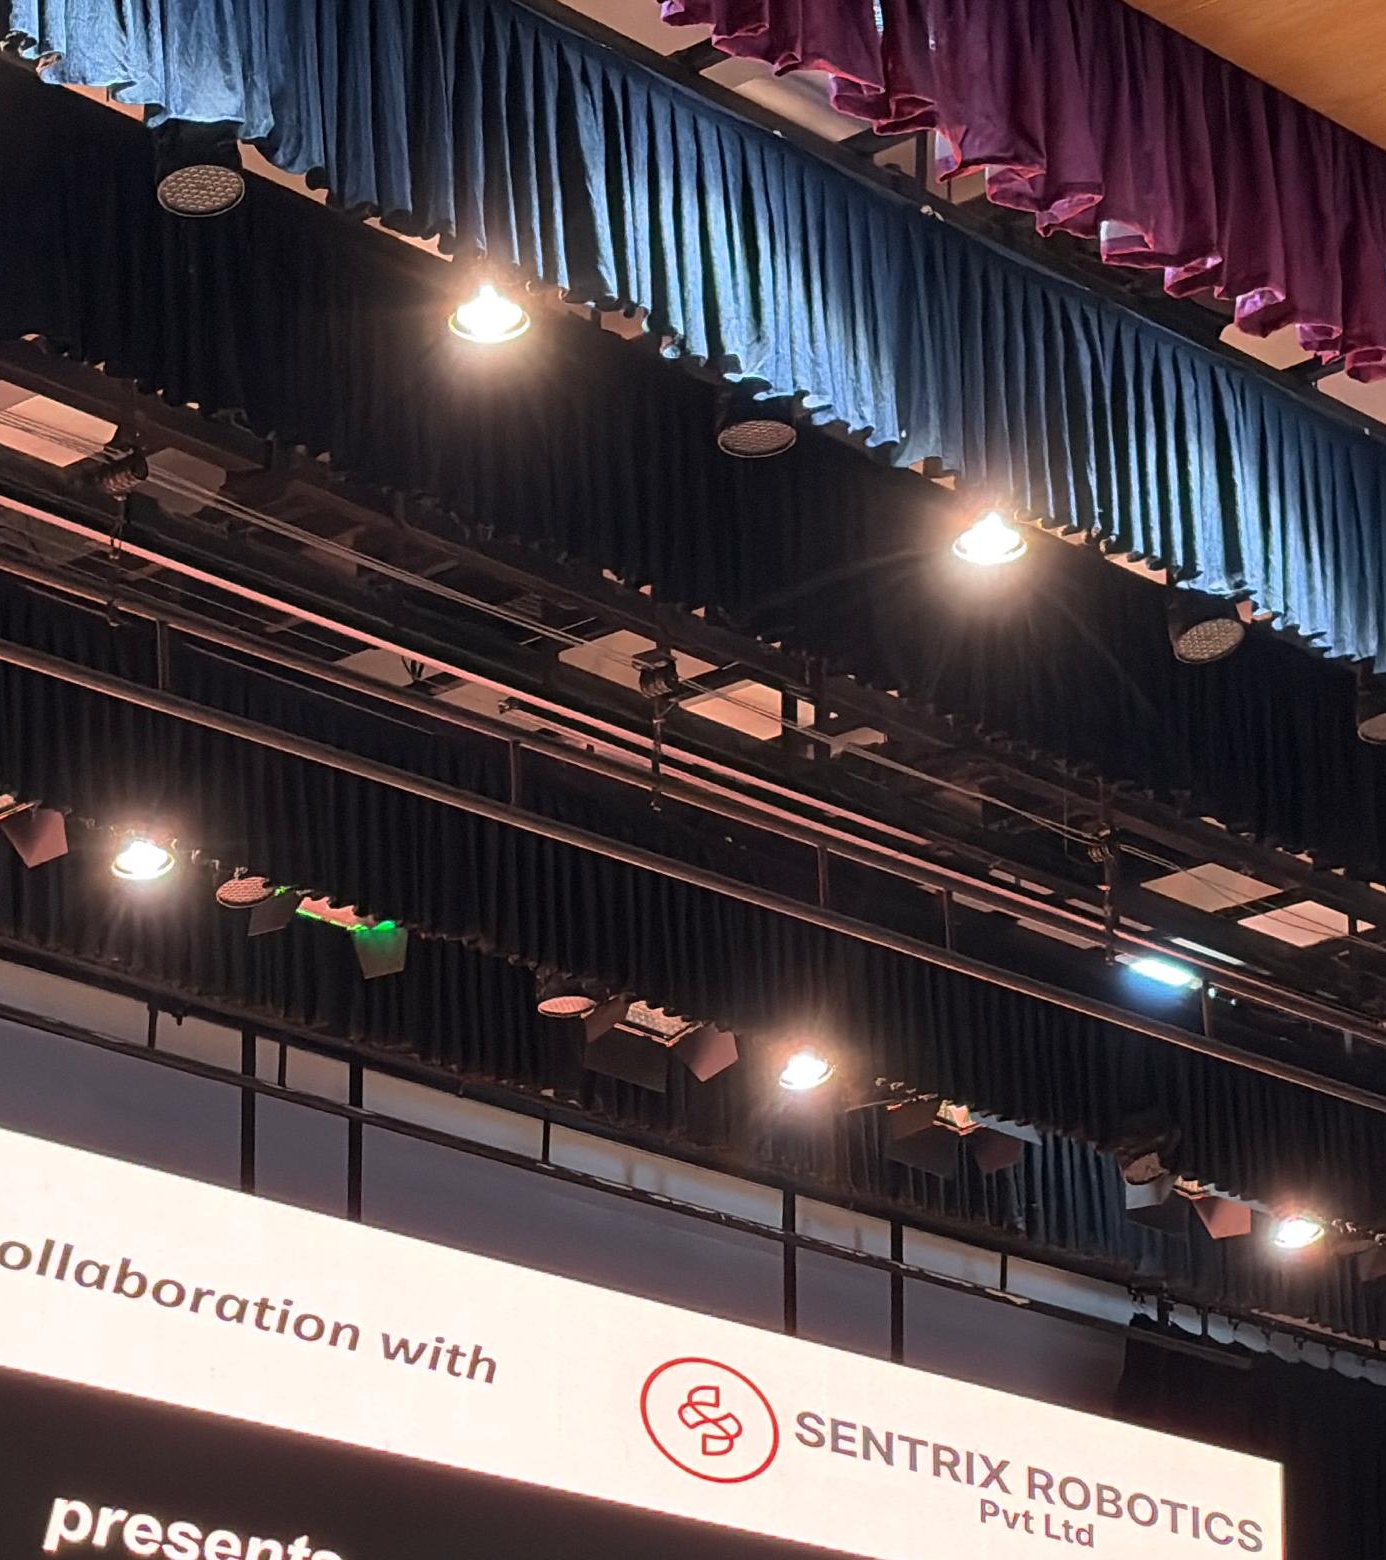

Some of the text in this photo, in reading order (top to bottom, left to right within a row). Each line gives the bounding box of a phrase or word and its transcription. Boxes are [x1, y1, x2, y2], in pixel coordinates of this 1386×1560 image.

[381, 1330, 498, 1386] with
[794, 1411, 1263, 1553] SENTRIX ROBOTICS
[980, 1498, 1094, 1549] Pvt Ltd
